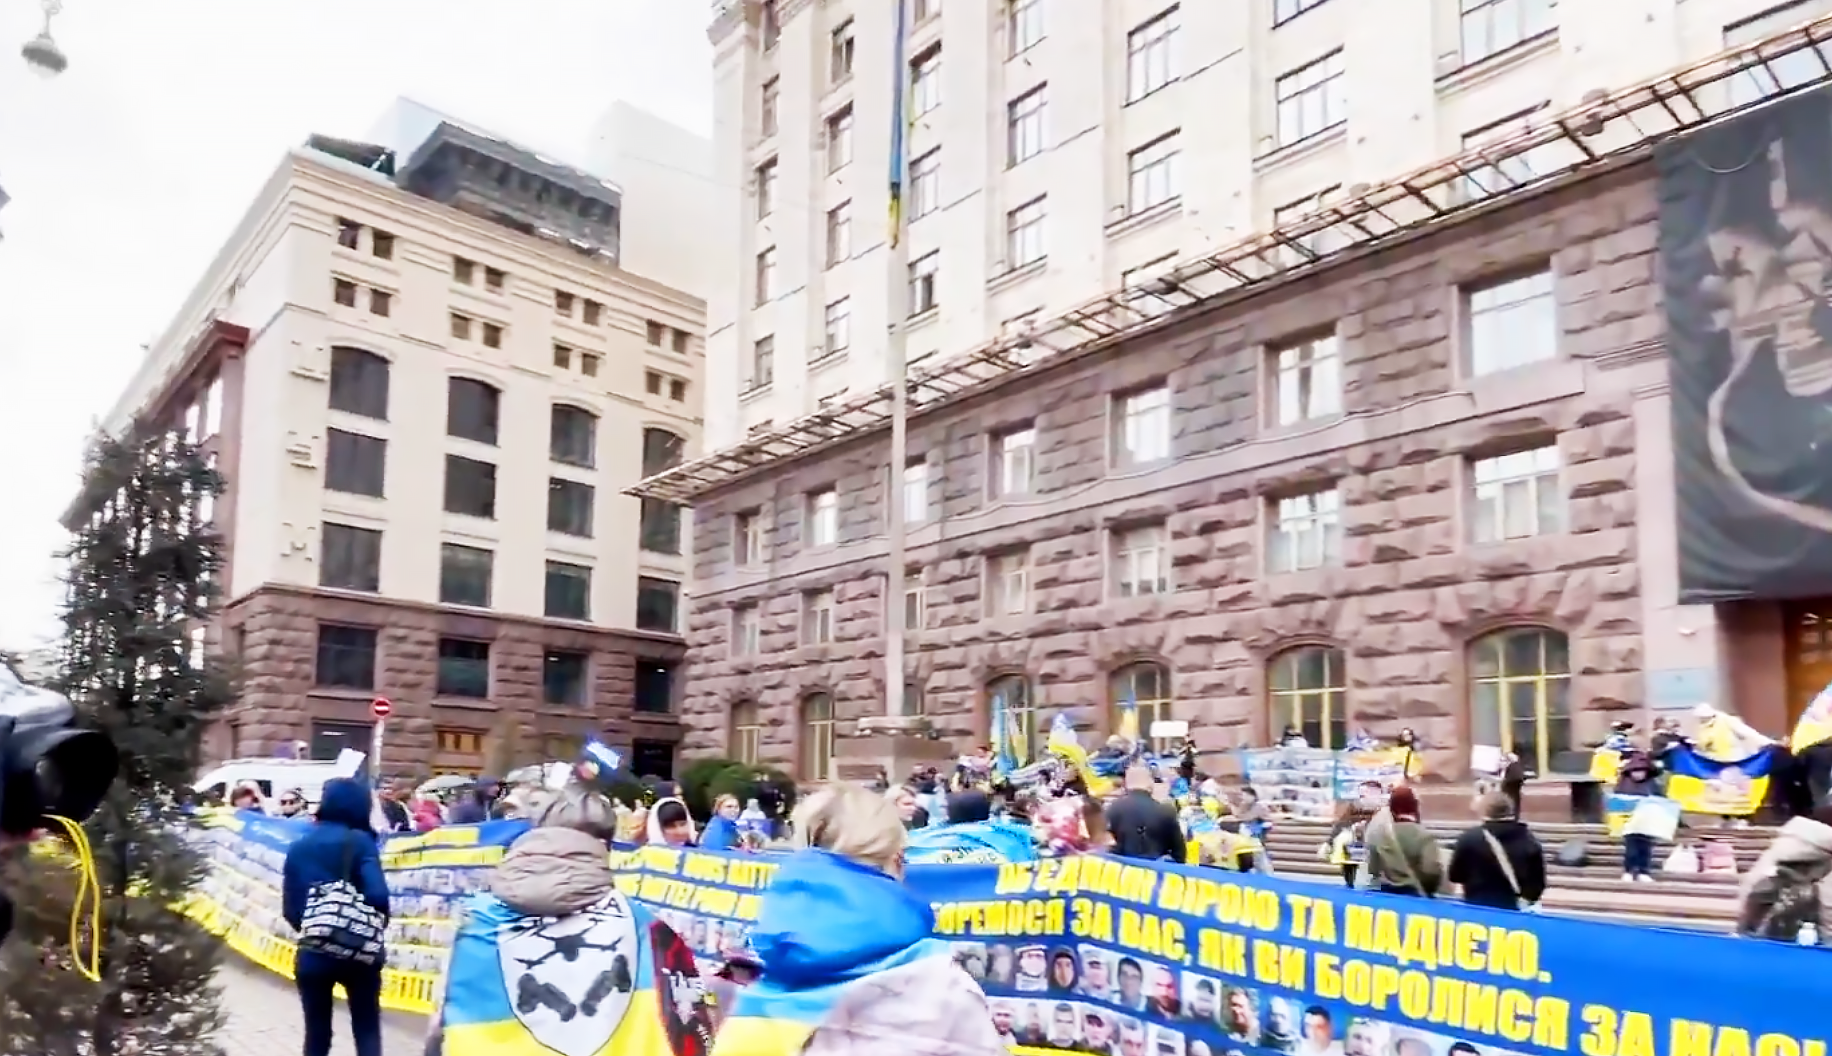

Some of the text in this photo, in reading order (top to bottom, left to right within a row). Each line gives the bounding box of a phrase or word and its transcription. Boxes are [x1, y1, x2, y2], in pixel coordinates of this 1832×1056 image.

[1070, 898, 1113, 942] ЗА
[1118, 907, 1192, 965] ВАС,
[1197, 926, 1247, 977] ЯК
[1252, 939, 1305, 990] ВИ
[1313, 951, 1570, 1051] БОРОЛИСЯ
[1580, 1003, 1655, 1056] ЗА
[1669, 1017, 1827, 1056] НА
[1158, 872, 1280, 932] ВІРОЮ
[1289, 893, 1336, 945] ТА
[1344, 902, 1552, 984] НАДІЄЮ.
